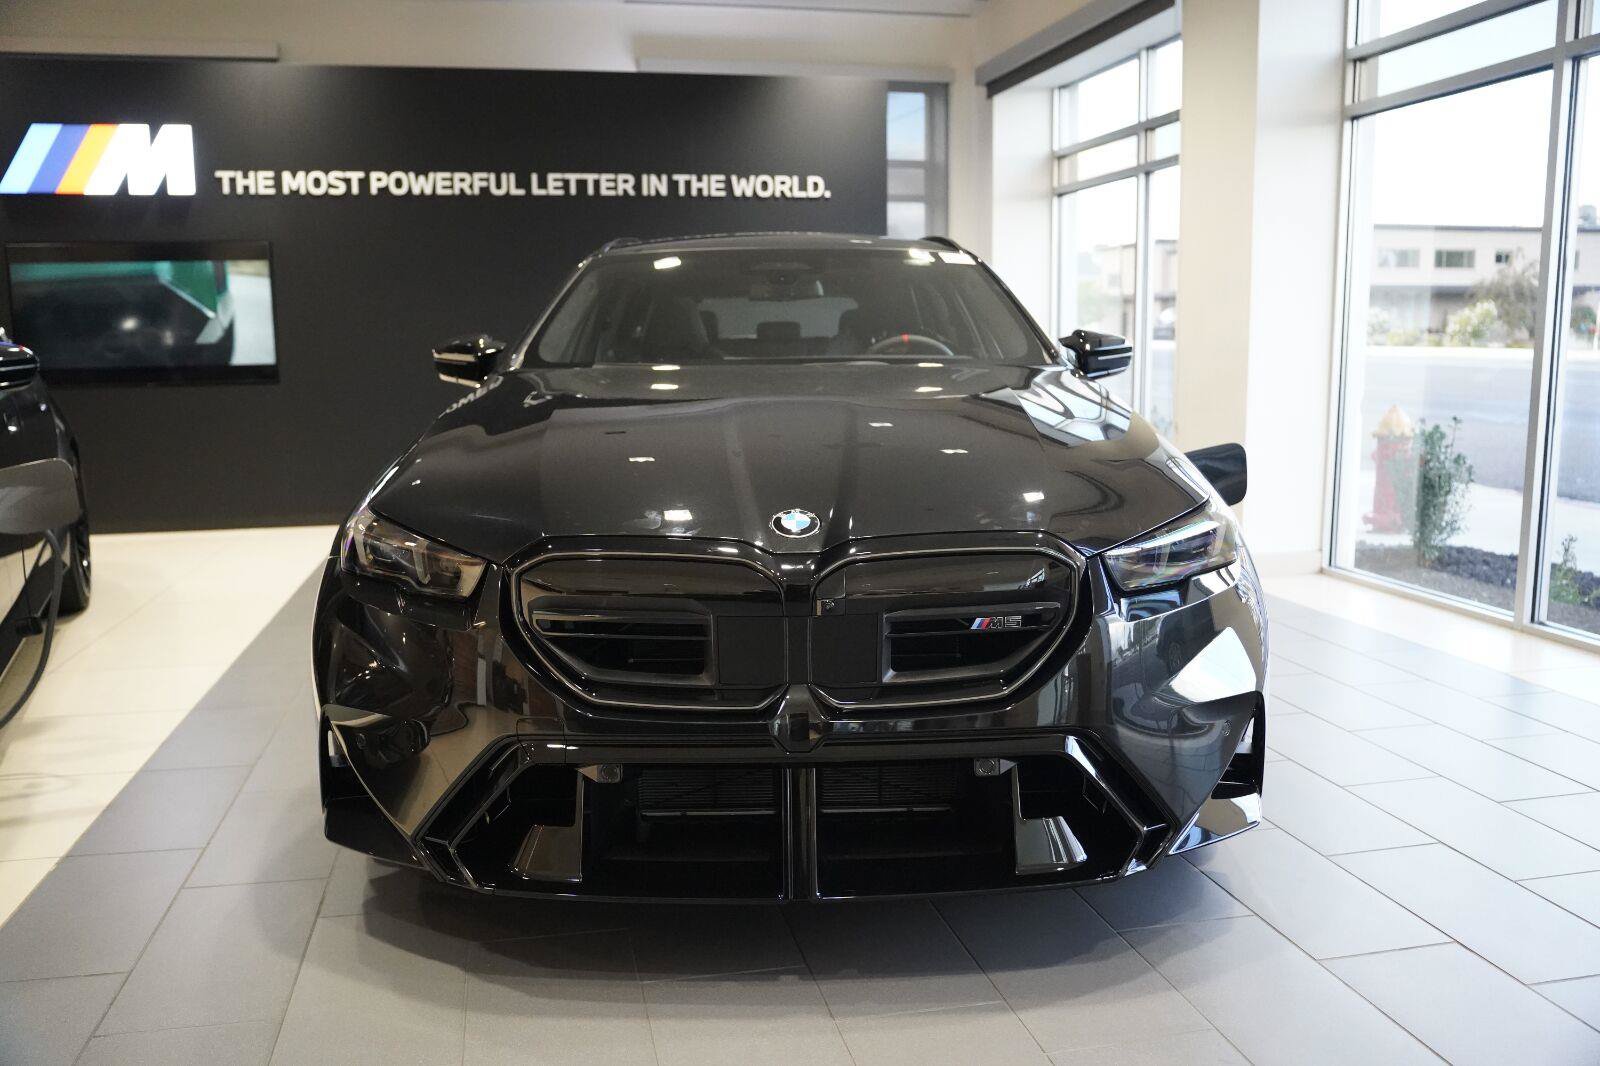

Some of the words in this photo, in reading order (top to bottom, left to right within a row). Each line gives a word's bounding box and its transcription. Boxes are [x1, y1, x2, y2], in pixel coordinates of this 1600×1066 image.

[83, 123, 197, 196] M
[214, 170, 276, 196] THE
[281, 170, 365, 196] MOST
[369, 171, 526, 196] POWERFUL
[530, 172, 636, 197] LETTER
[641, 173, 669, 197] IN
[672, 173, 727, 198] THE
[730, 174, 832, 199] WORLD.
[988, 615, 1022, 630] M5
